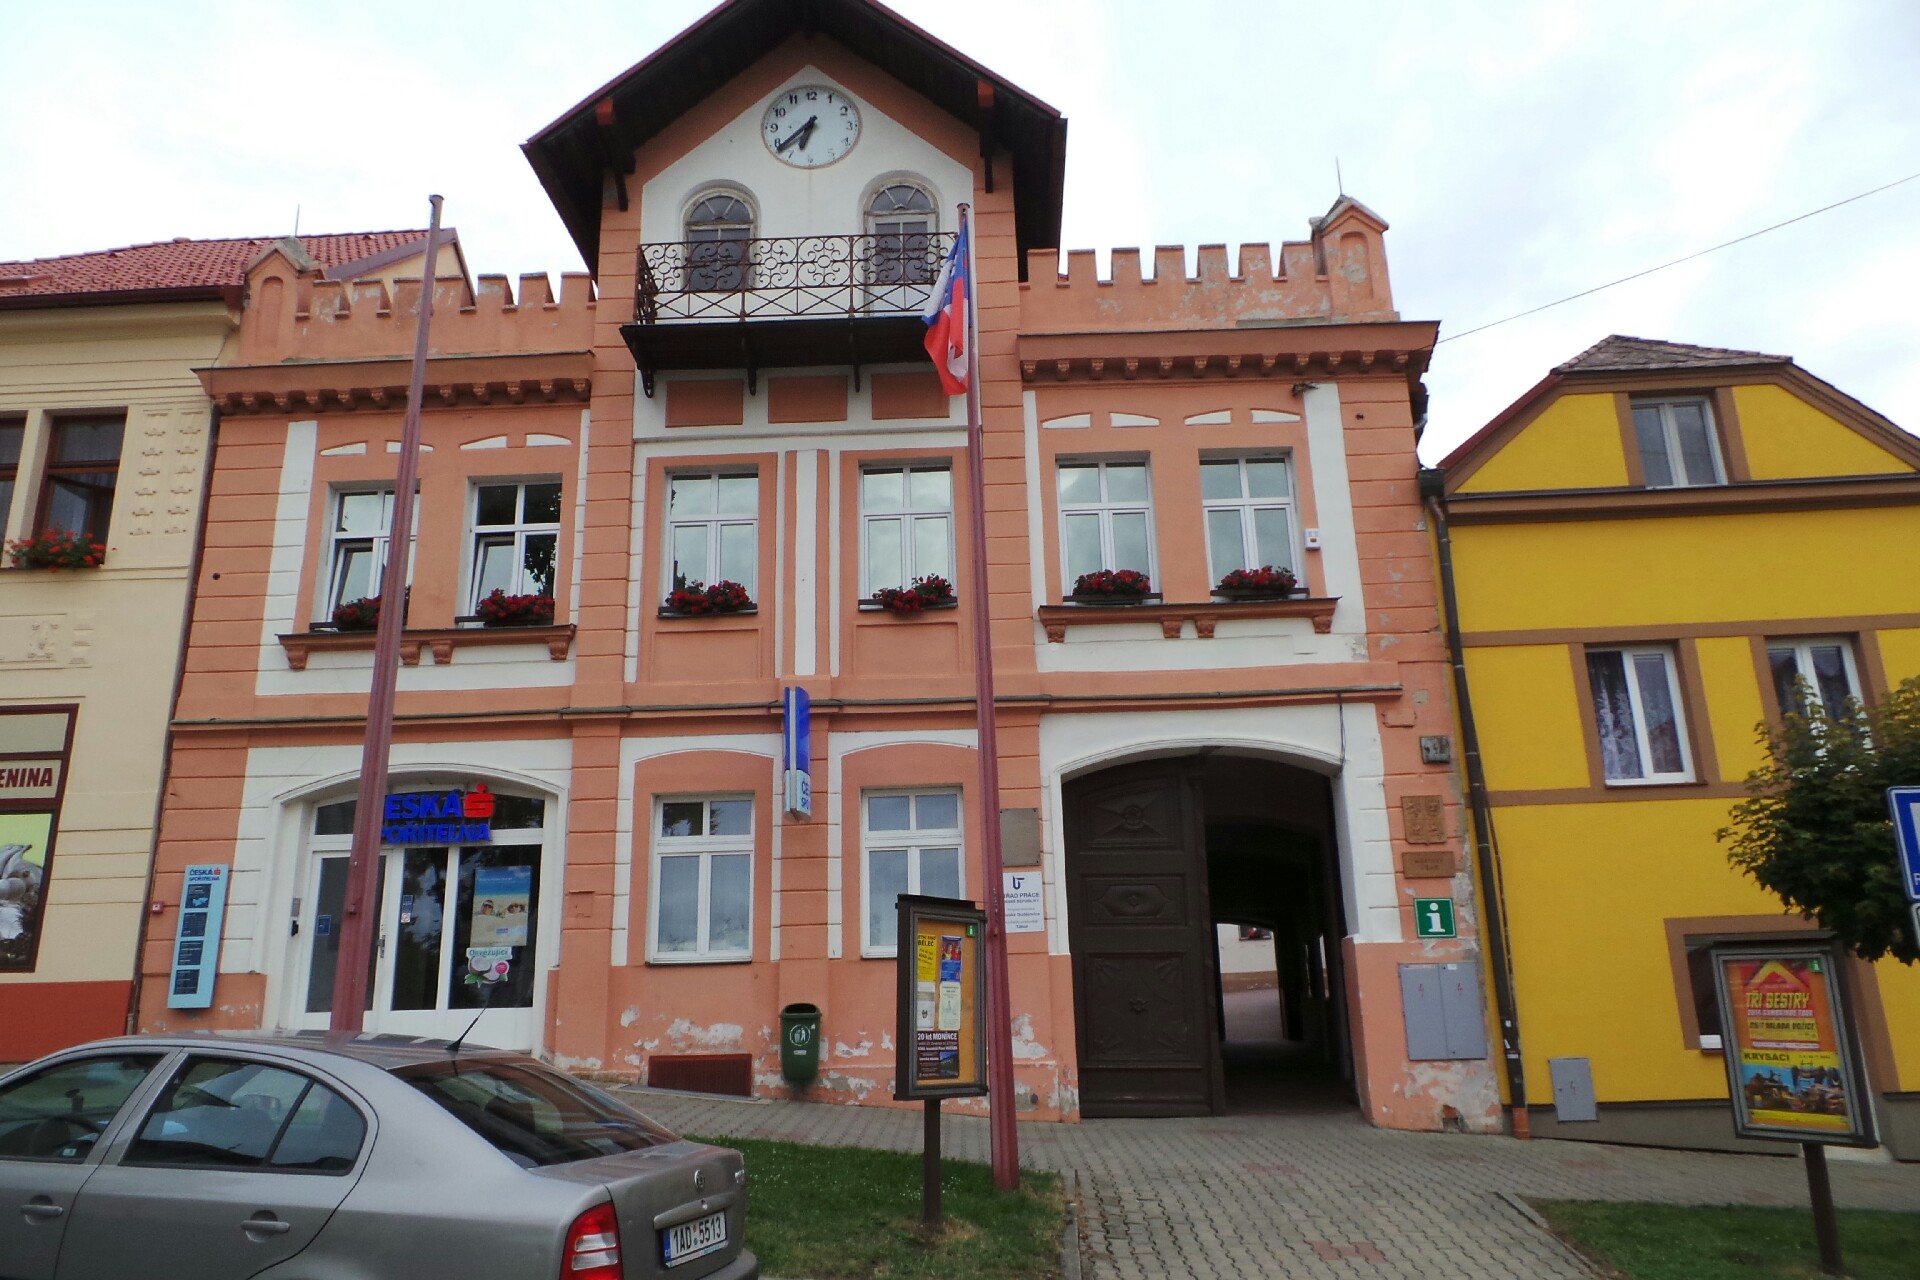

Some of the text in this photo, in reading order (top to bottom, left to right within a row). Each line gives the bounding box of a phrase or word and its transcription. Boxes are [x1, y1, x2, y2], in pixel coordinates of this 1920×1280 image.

[789, 95, 798, 104] 11
[806, 92, 817, 100] 12
[828, 94, 832, 103] 1
[775, 108, 786, 117] 10
[840, 106, 848, 116] 2
[770, 124, 778, 132] 9
[846, 121, 853, 131] 3
[385, 789, 463, 819] ESKÁ
[1766, 992, 1809, 1009] SESTRY
[673, 1217, 721, 1254] 1AD 5513
